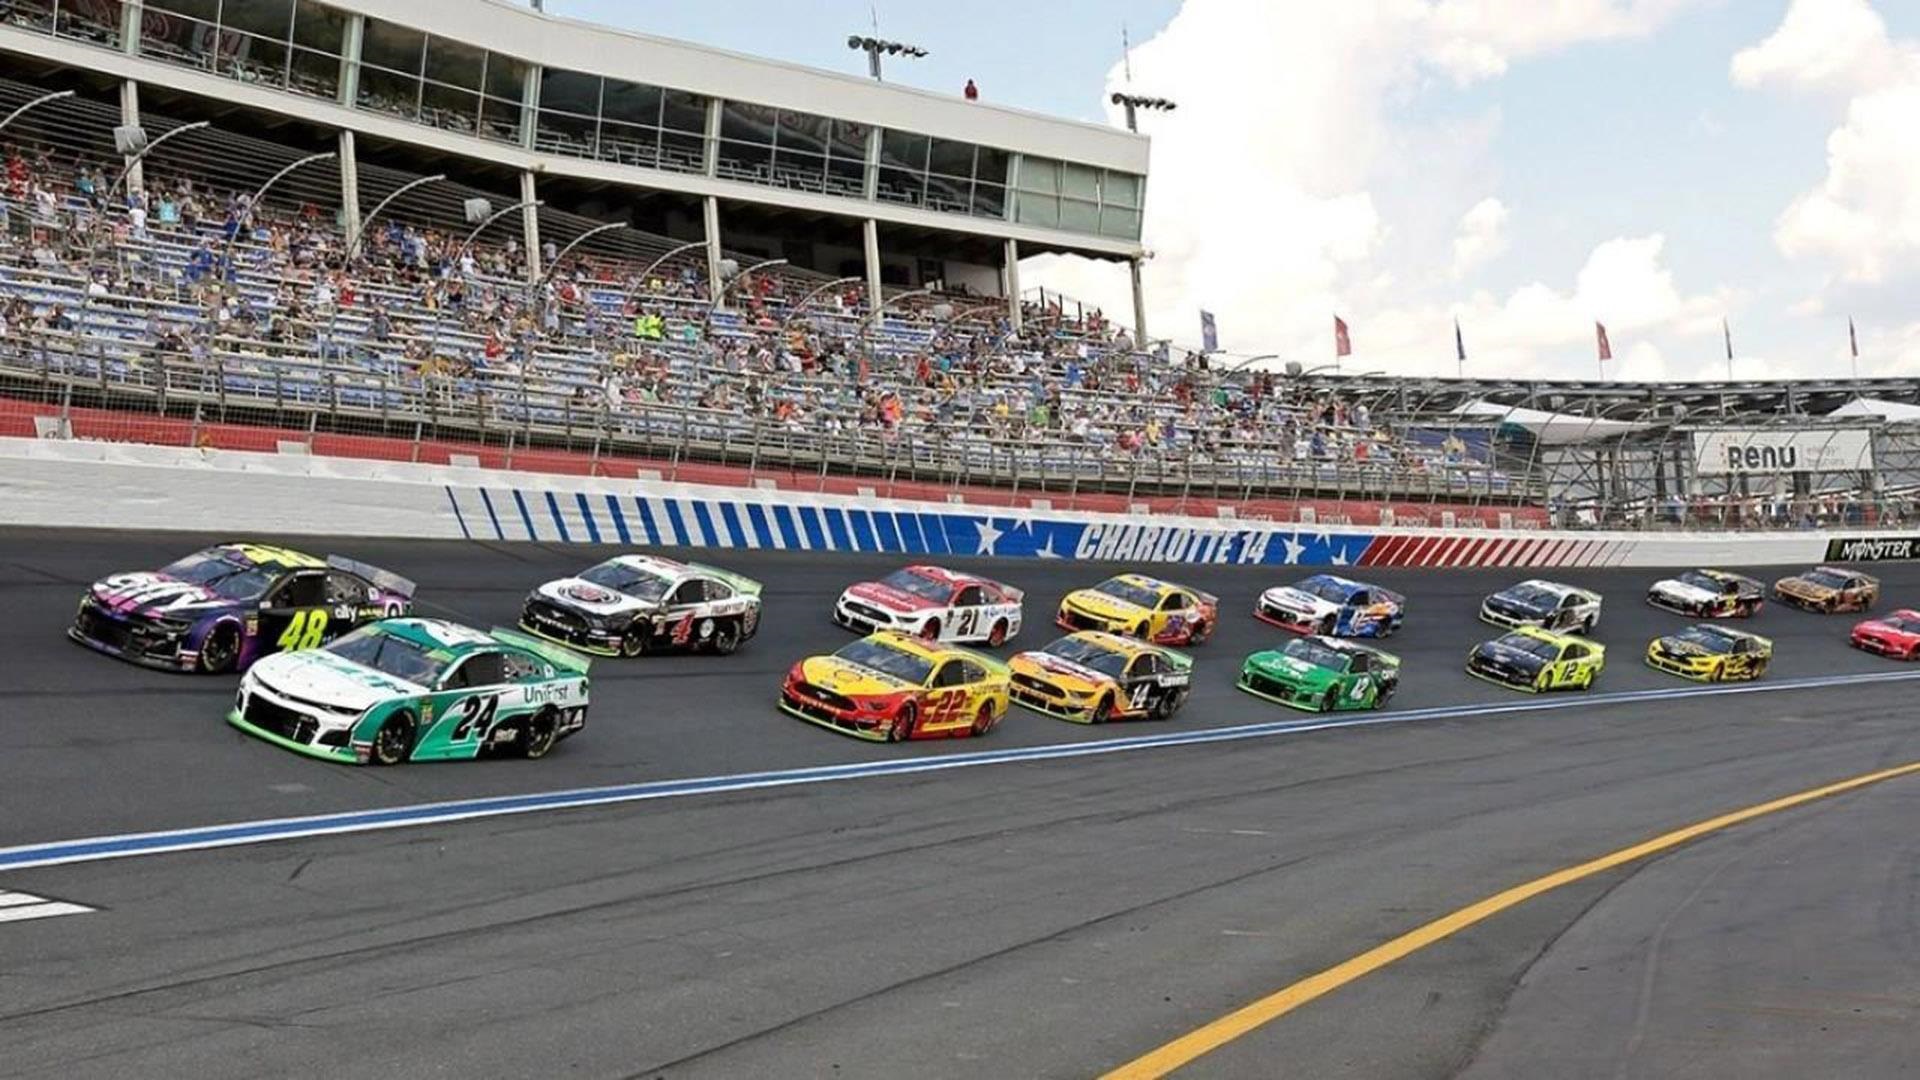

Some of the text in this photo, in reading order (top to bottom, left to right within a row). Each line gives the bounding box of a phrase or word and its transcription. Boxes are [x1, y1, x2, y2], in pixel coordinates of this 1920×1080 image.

[1075, 523, 1273, 565] CHARLOTTE 14
[1841, 537, 1912, 561] MONSTER
[334, 603, 358, 623] ally
[957, 609, 981, 636] 21
[276, 608, 329, 651] 48
[670, 610, 697, 645] 4
[1563, 662, 1578, 681] 12
[523, 682, 569, 704] UniFrst
[1128, 682, 1151, 709] 14
[451, 694, 500, 742] 24
[929, 689, 967, 725] 22
